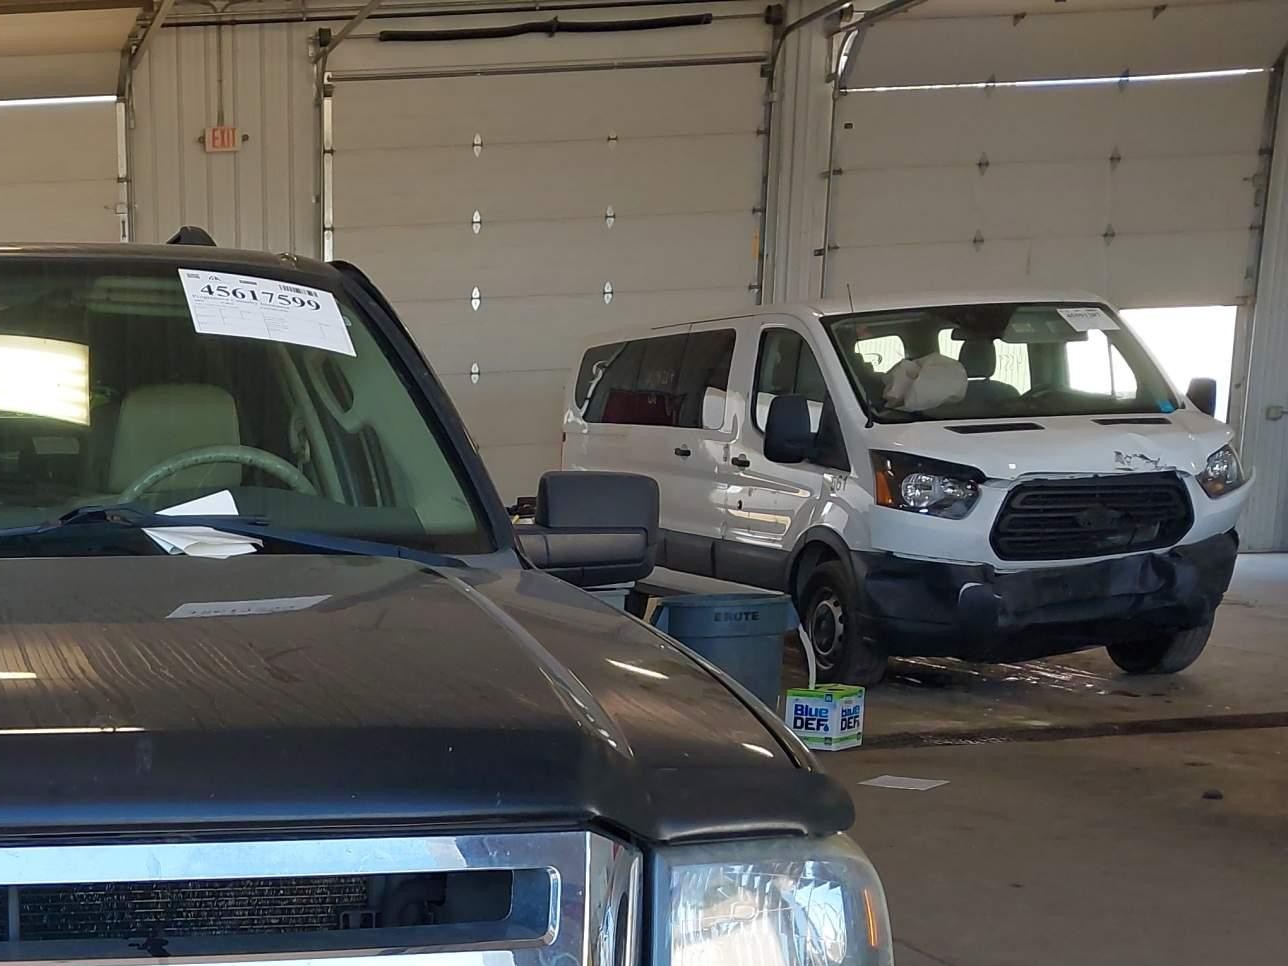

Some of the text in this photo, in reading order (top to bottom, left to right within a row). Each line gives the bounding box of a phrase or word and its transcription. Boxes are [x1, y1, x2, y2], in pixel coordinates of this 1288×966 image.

[213, 128, 236, 149] EXIT
[200, 284, 321, 311] 45617599
[793, 704, 829, 717] Blue
[793, 716, 829, 731] DEF
